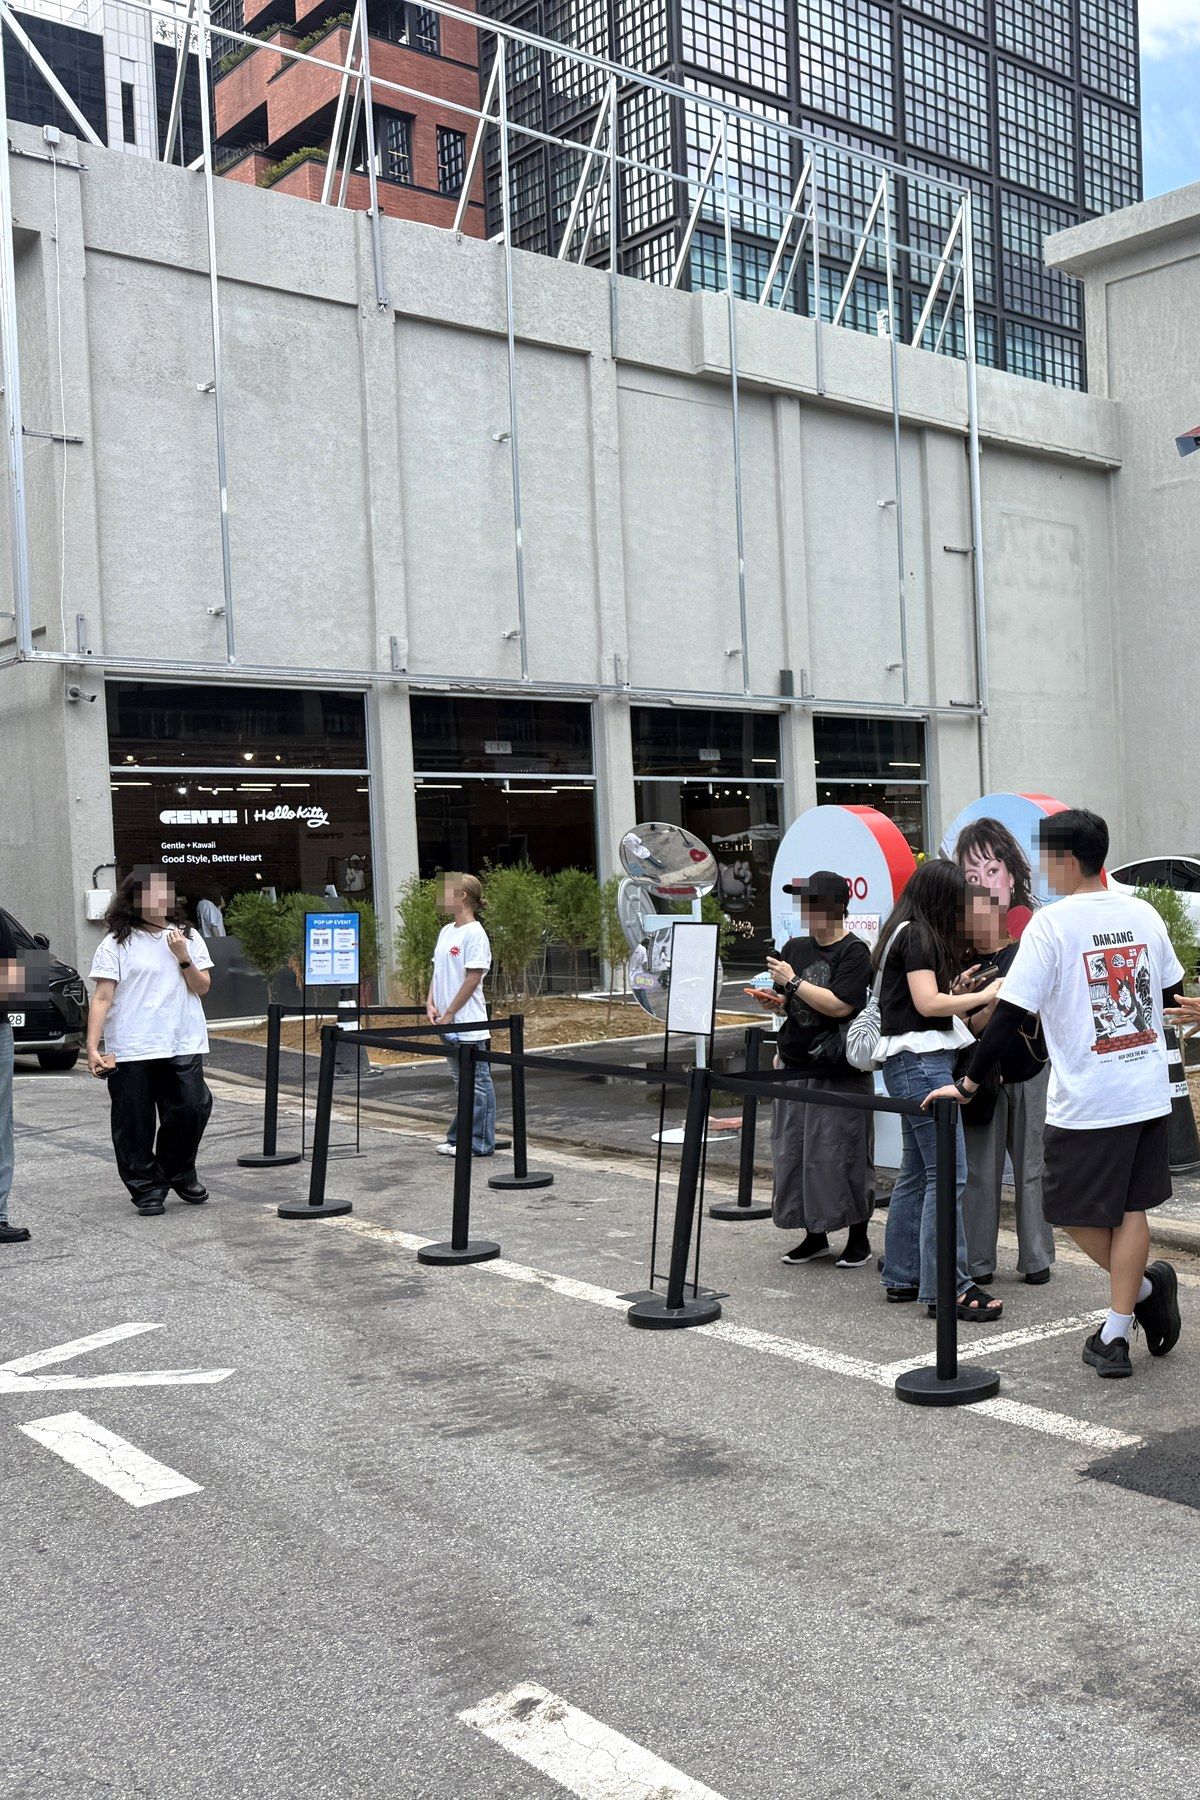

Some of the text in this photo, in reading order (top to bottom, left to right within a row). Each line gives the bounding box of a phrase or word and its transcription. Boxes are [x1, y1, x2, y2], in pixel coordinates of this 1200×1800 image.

[161, 841, 186, 849] Gentle
[192, 841, 217, 849] Kawaii
[161, 853, 263, 865] Good Style, Better Heart
[1092, 931, 1134, 947] DAMJANG
